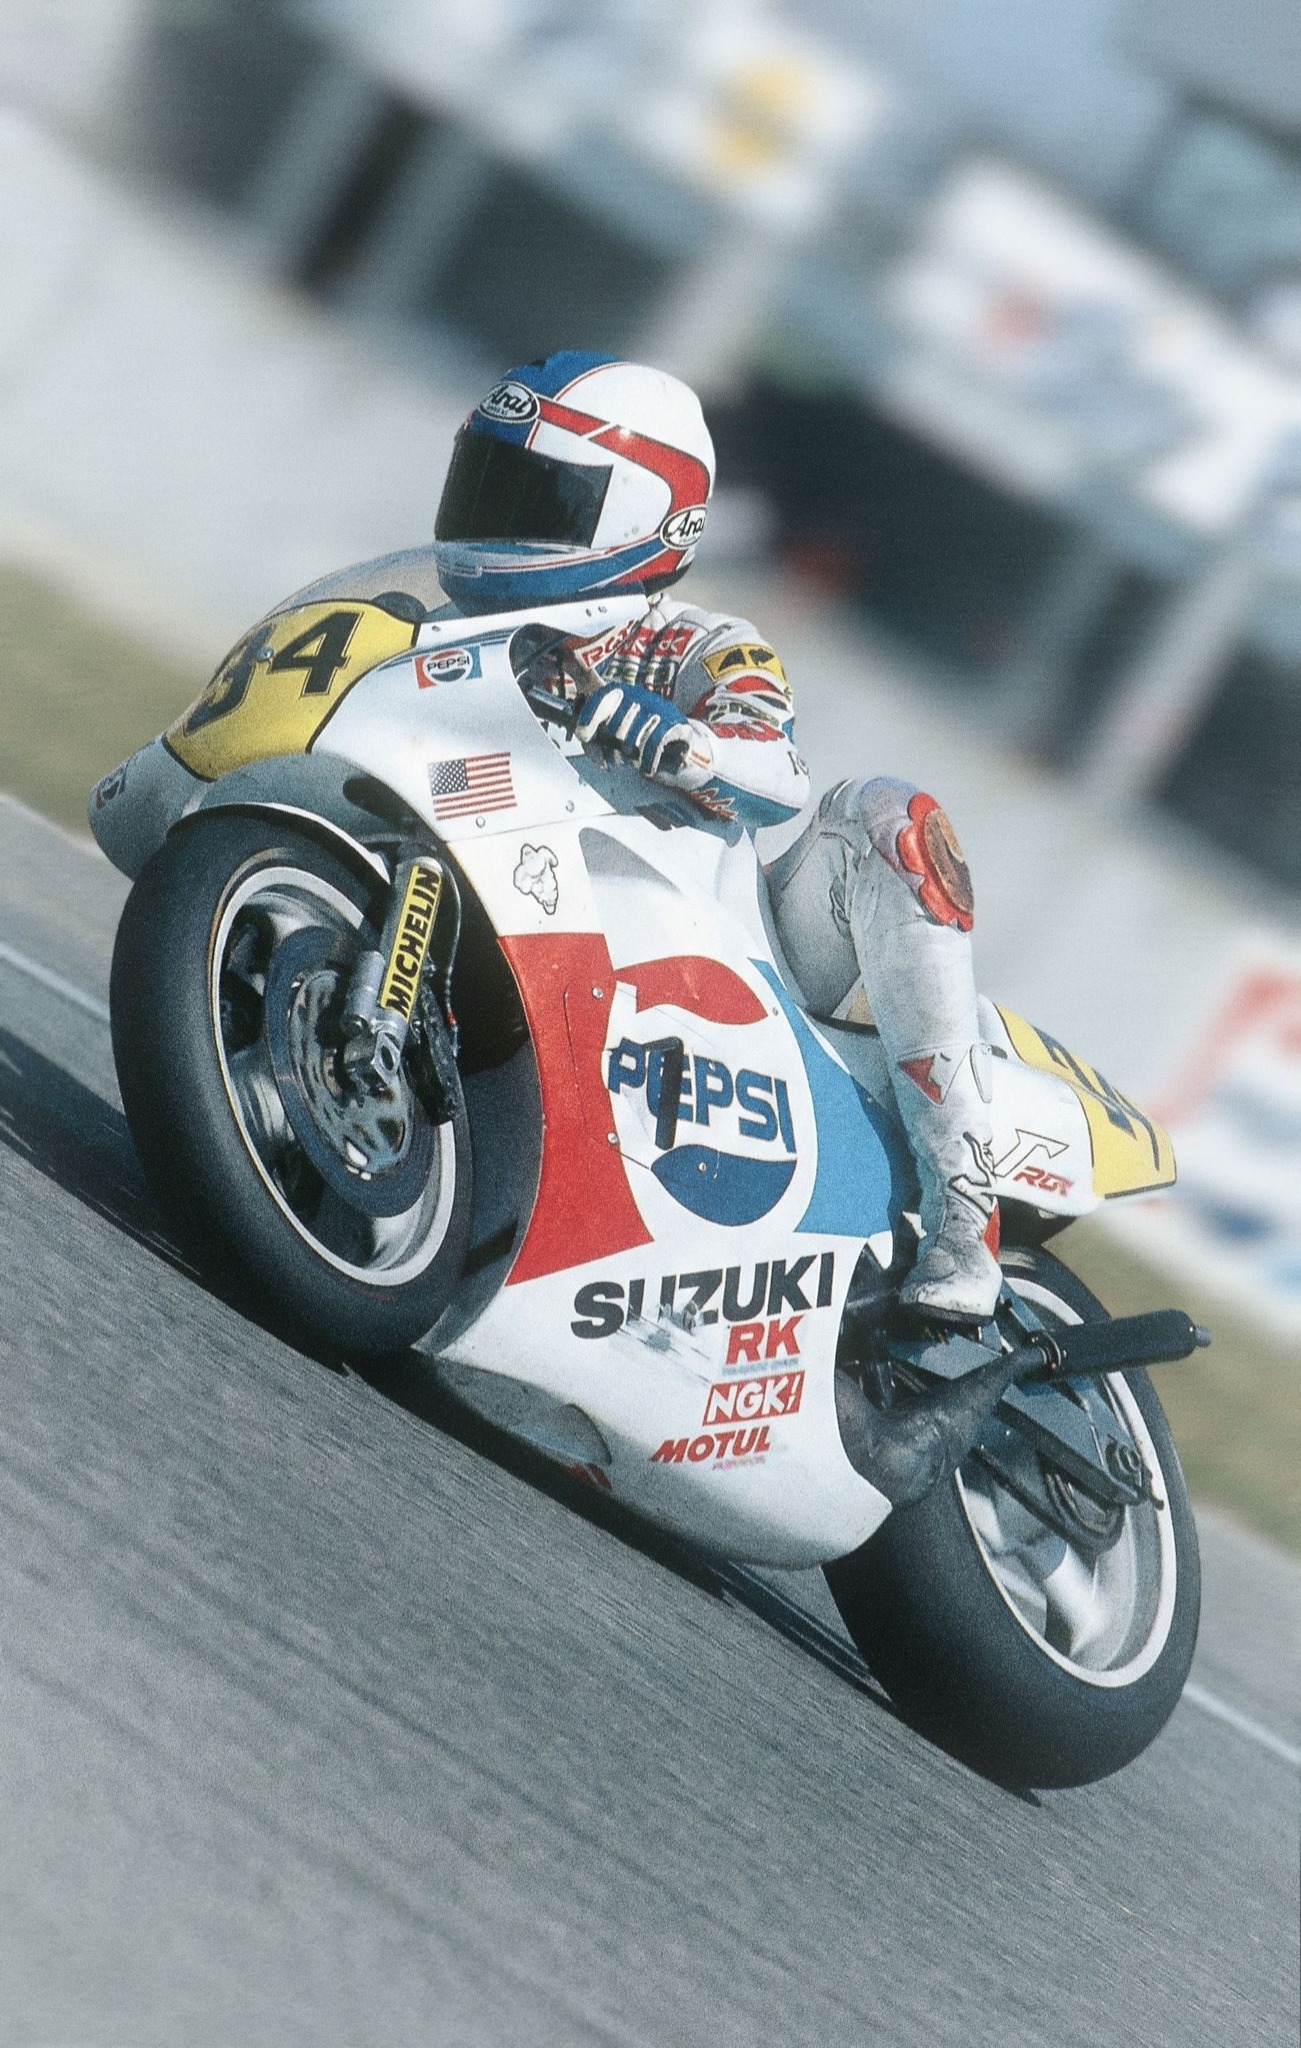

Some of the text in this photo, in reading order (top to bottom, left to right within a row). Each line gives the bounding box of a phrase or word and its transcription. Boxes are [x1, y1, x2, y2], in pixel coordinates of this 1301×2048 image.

[427, 655, 470, 672] PEPSI
[385, 867, 440, 1018] MICHELIN
[608, 1037, 797, 1153] PEPSI
[570, 1251, 835, 1340] SUZUKI
[725, 1314, 804, 1365] RK
[651, 1425, 770, 1463] MOTUL
